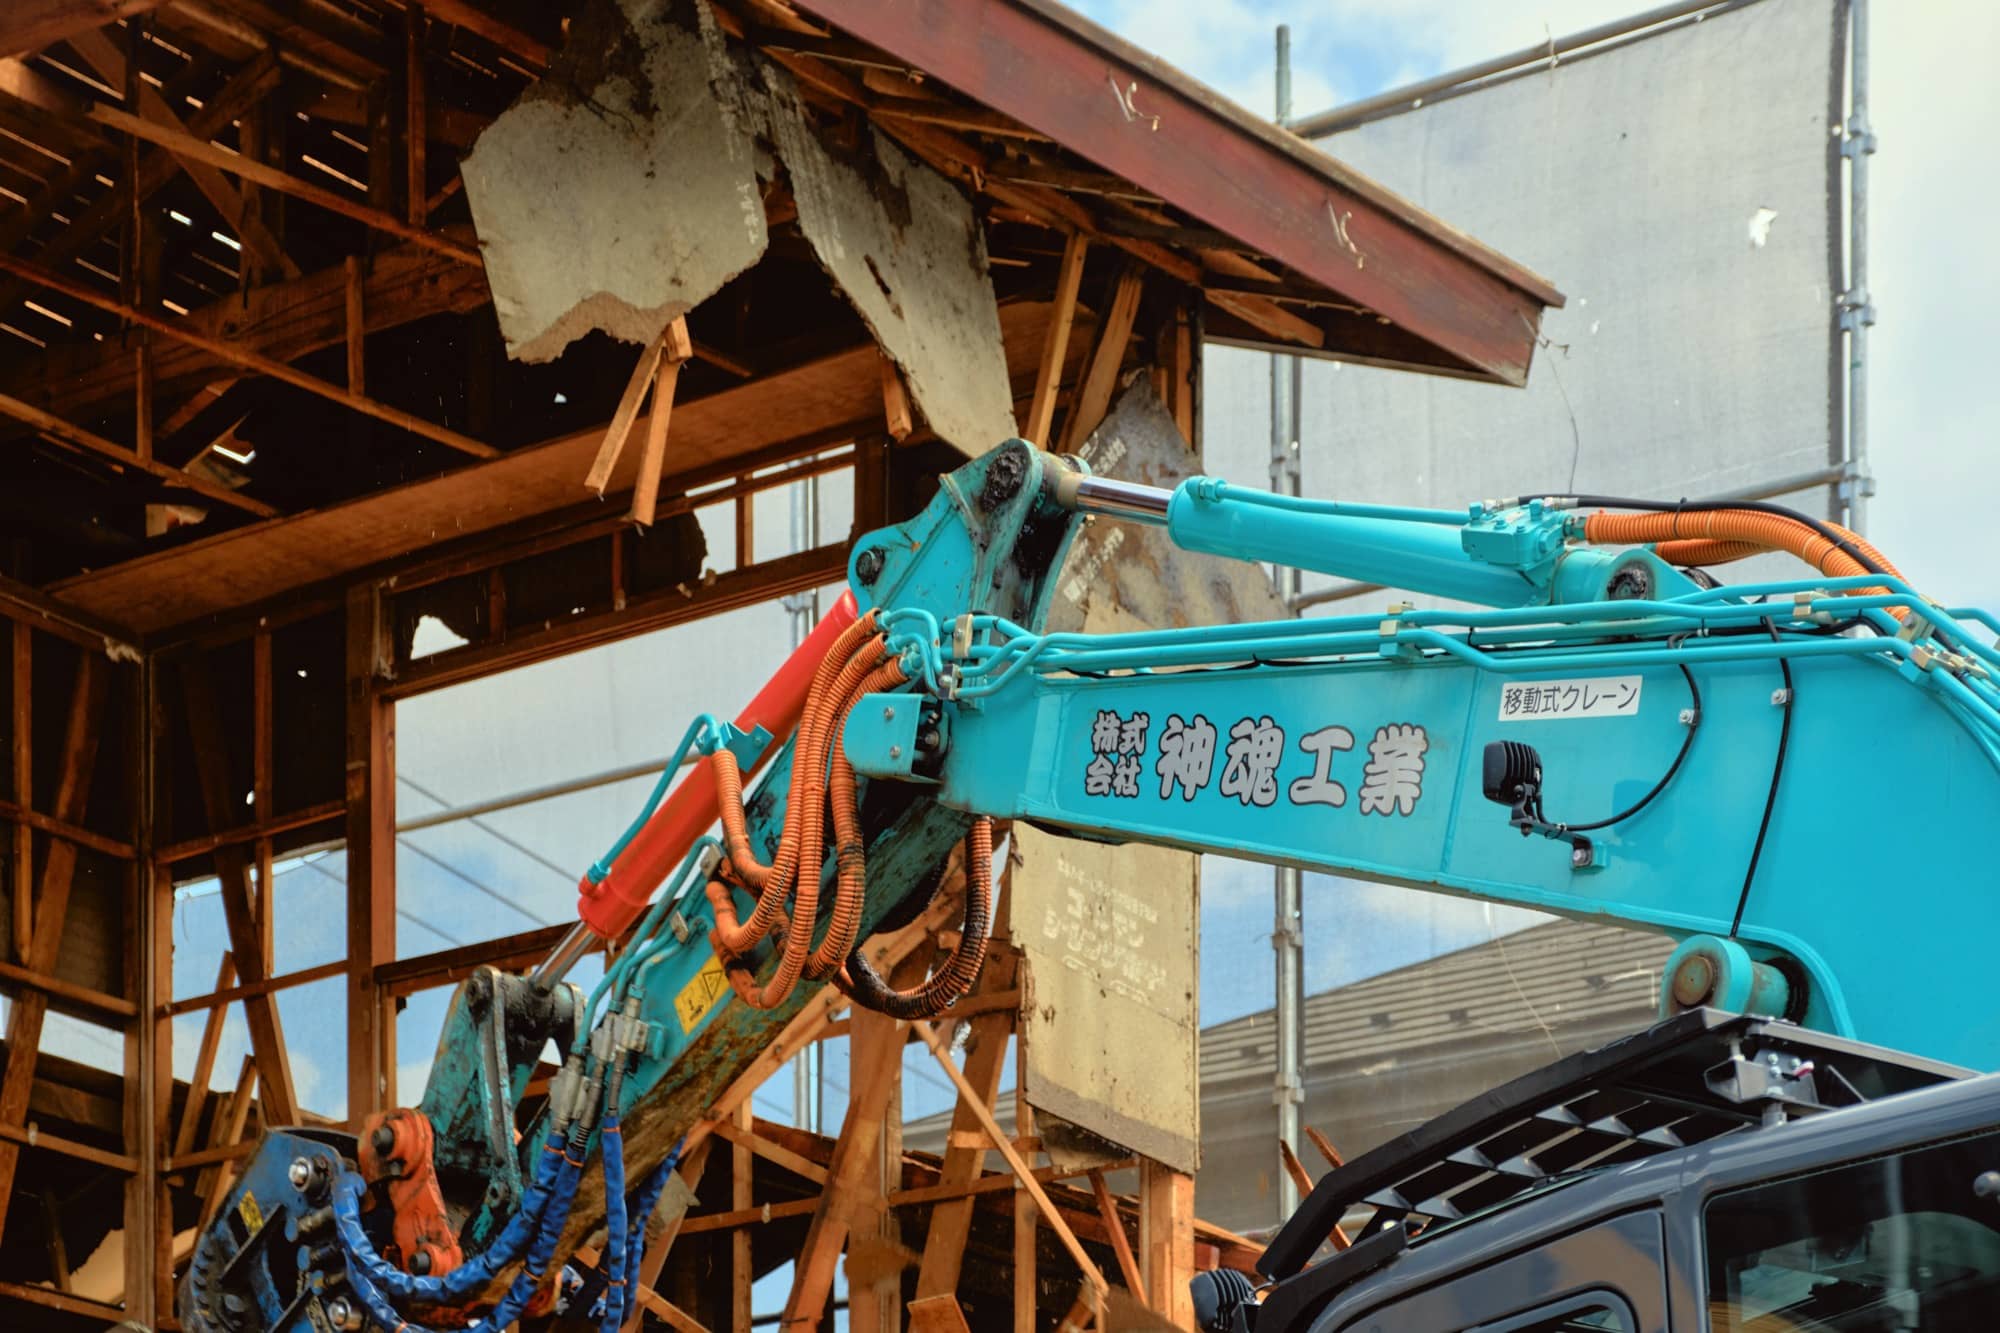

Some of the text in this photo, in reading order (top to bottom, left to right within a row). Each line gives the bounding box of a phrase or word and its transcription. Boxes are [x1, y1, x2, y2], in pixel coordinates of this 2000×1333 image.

[1503, 683, 1638, 716] 移動式クレーン
[1092, 709, 1150, 754] 株式
[1085, 754, 1142, 798] 会社
[1157, 714, 1430, 817] 神魂工業
